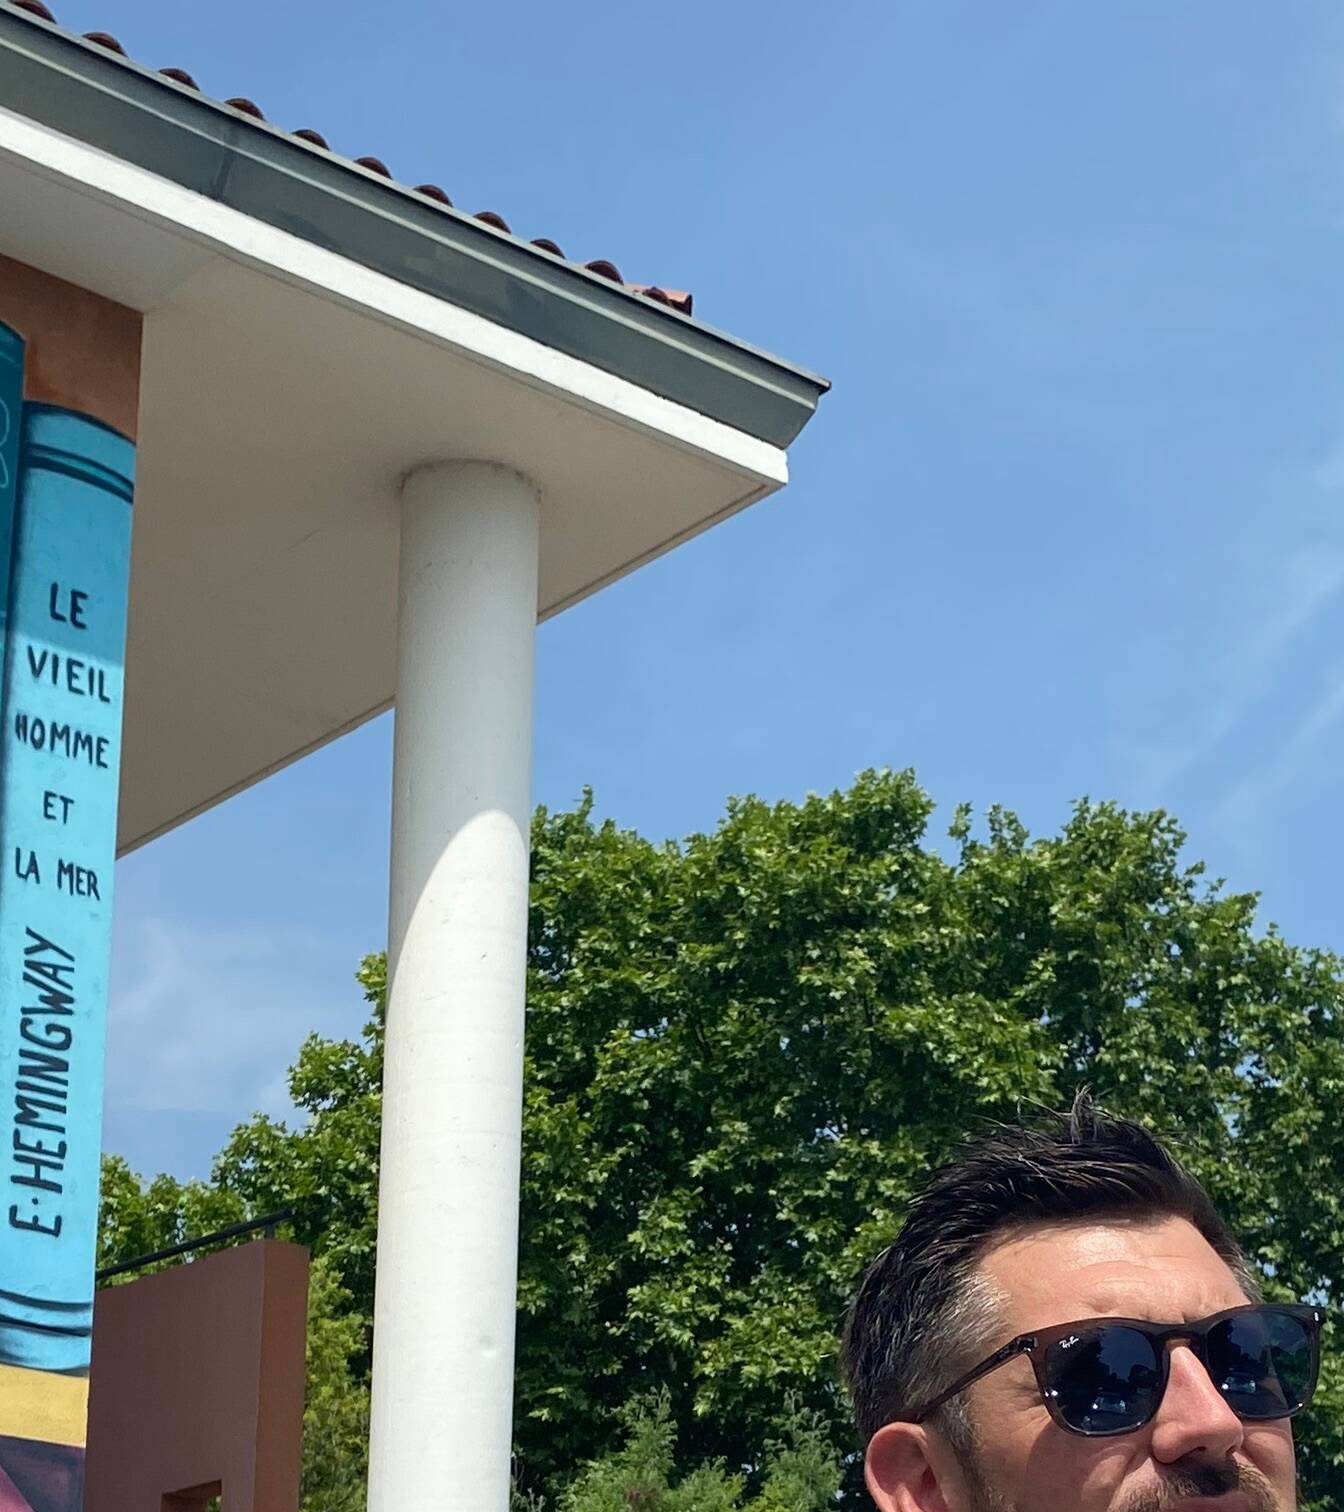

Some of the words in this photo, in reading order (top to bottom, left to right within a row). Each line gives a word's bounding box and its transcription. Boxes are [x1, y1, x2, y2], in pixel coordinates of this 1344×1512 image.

[49, 581, 89, 630] LE
[26, 644, 112, 704] VIEIL
[14, 712, 109, 769] HOMME
[43, 790, 75, 825] ET
[14, 846, 41, 885] LA
[57, 857, 101, 901] MER
